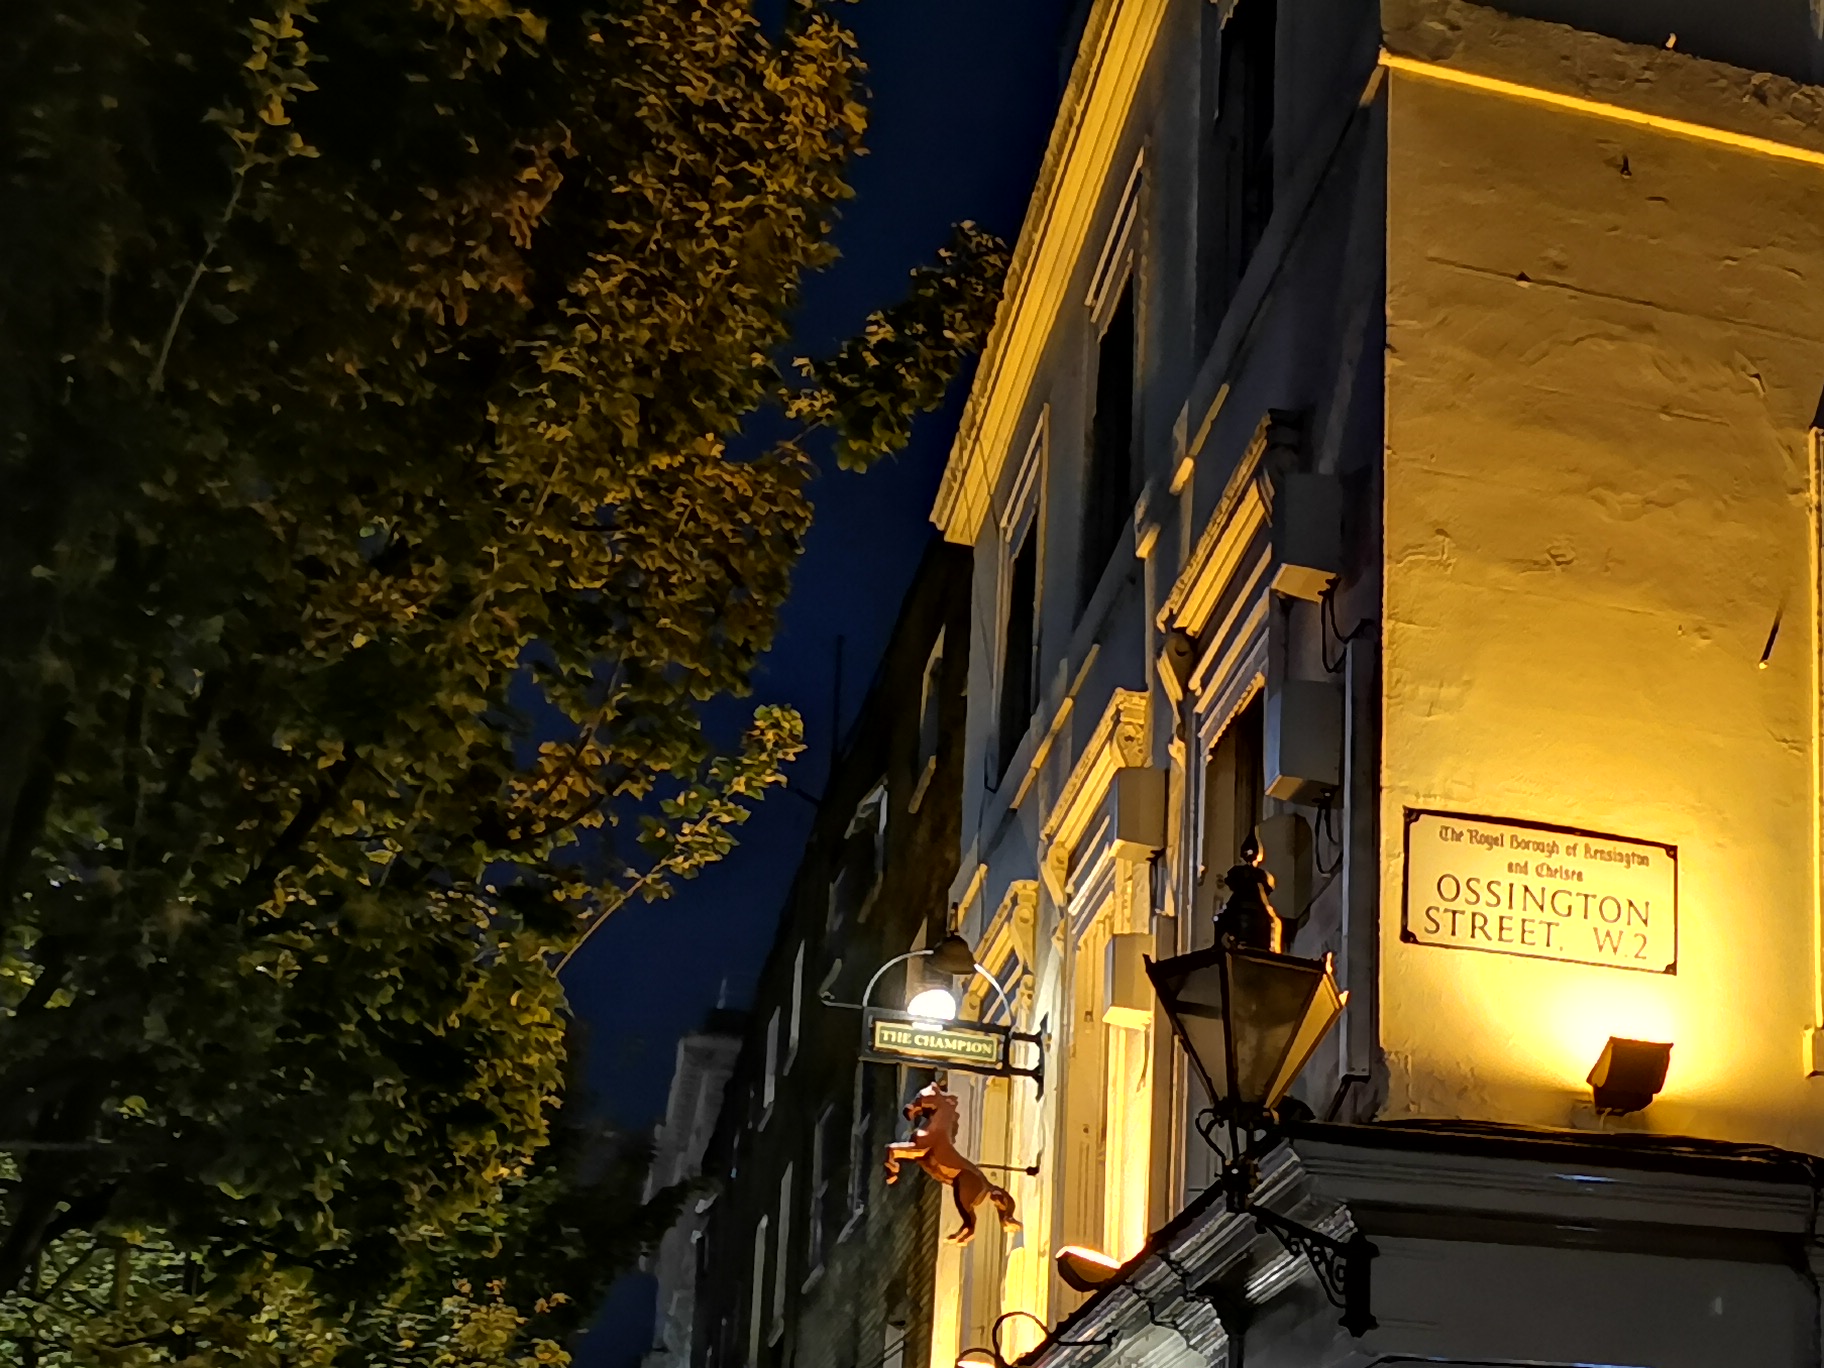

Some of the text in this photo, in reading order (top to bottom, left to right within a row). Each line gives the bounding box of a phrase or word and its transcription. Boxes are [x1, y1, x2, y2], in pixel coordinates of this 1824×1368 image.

[1438, 825, 1650, 869] The Royal Borough of Kensington
[1507, 860, 1584, 882] and Chelsea
[1436, 873, 1650, 928] OSSINGTON
[1592, 926, 1648, 960] W.2
[880, 1029, 993, 1055] THE CHAMPION
